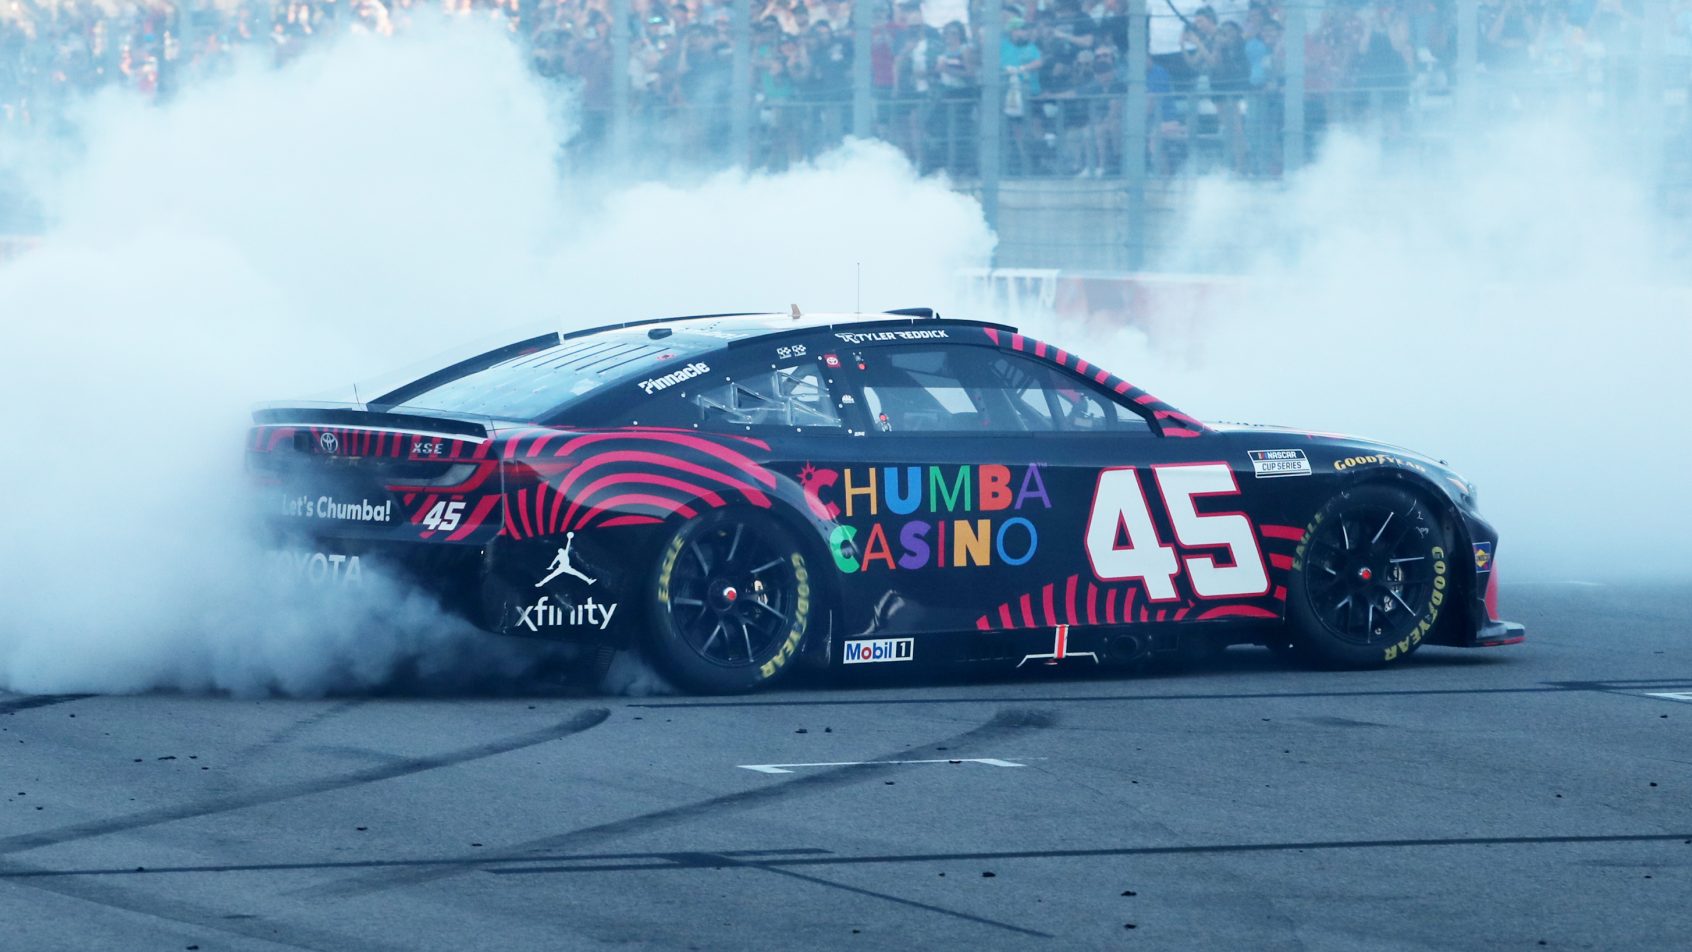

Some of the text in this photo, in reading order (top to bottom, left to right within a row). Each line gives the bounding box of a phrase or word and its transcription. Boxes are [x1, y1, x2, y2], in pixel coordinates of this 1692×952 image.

[856, 332, 897, 342] TYLER
[894, 330, 949, 339] REDDICK
[638, 361, 710, 395] Pinnacle
[412, 443, 444, 454] XSE
[1267, 451, 1297, 459] NASCAR
[1262, 461, 1302, 471] CUP SERIES
[800, 460, 1052, 521] CHUMBA
[282, 494, 391, 522] Let's Chumba!
[422, 501, 467, 531] 45
[829, 516, 1038, 574] CASINO
[1085, 461, 1270, 601] 45
[515, 596, 618, 632] xfinity
[1383, 545, 1446, 661] GOODYEAR
[846, 641, 893, 661] Mobil
